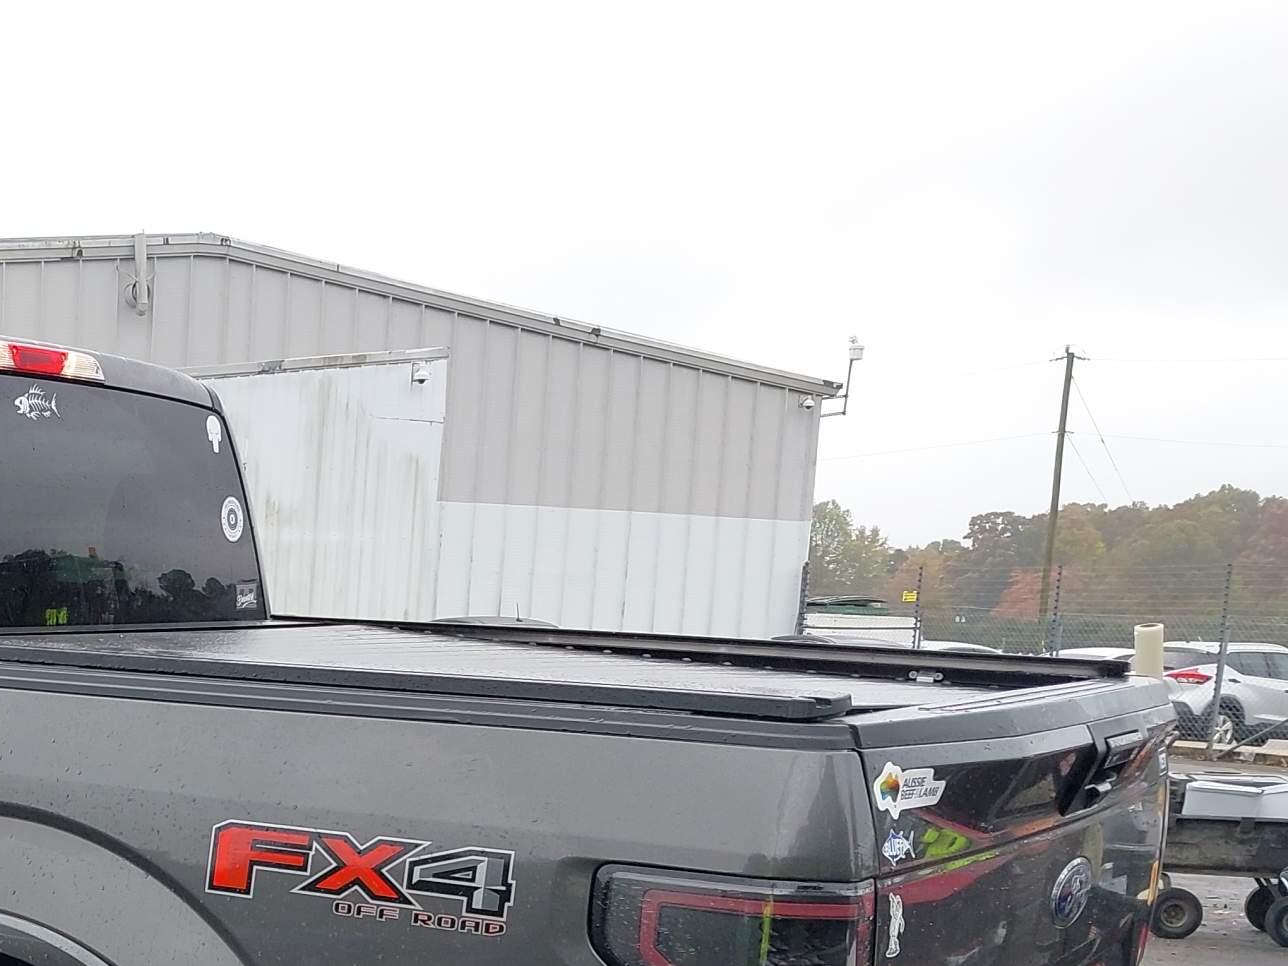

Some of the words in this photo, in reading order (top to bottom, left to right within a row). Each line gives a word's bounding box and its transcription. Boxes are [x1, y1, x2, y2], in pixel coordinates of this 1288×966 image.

[902, 776, 928, 789] AUSSIE
[205, 819, 516, 921] FX4
[333, 899, 401, 922] OFF
[411, 910, 508, 938] ROAD
